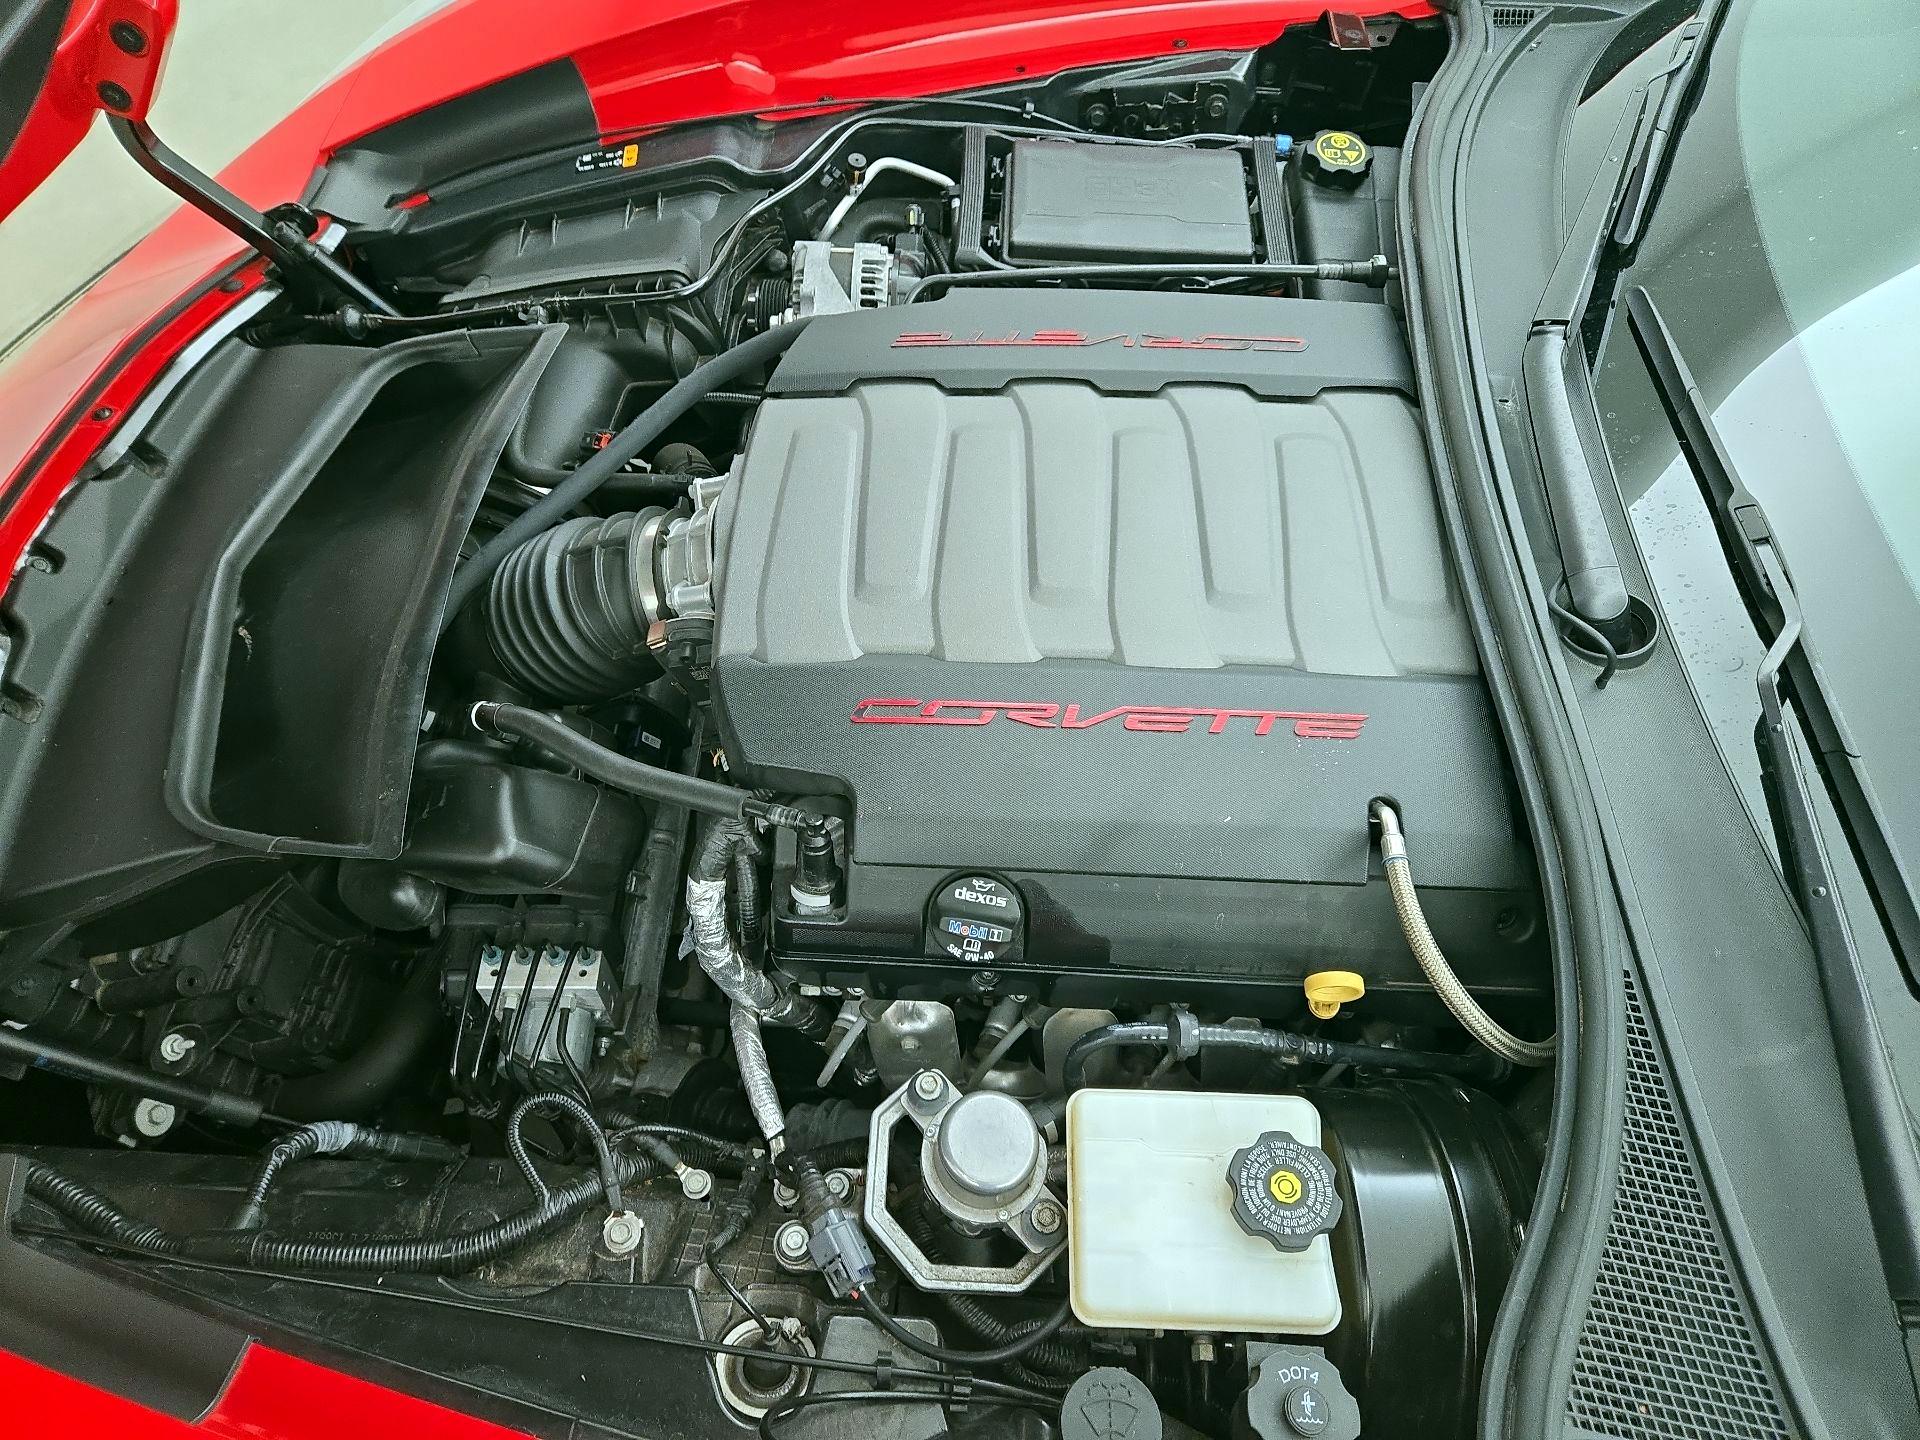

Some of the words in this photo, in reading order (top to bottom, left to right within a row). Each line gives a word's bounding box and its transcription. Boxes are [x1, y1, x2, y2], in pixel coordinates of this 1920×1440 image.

[890, 330, 1310, 352] CORVETTE
[849, 698, 1369, 739] CORVETTE
[954, 887, 1007, 907] dexos
[948, 920, 988, 940] Mobil
[947, 944, 963, 958] SAE
[965, 951, 995, 961] 0W-40
[1270, 1149, 1285, 1157] ONLY
[1286, 1150, 1297, 1158] USE
[1301, 1148, 1321, 1167] SEALED
[1243, 1159, 1252, 1168] LA
[1248, 1162, 1261, 1178] FREIN
[1274, 1158, 1295, 1166] FILLER
[1294, 1161, 1311, 1178] CLEAN
[1240, 1167, 1248, 1185] AVANT
[1320, 1169, 1330, 1186] FROM
[1250, 1188, 1263, 1209] LIQUIDE
[1316, 1180, 1324, 1203] BEFORE
[1324, 1187, 1332, 1204] FLUID
[1241, 1188, 1257, 1214] BOUCHON
[1312, 1202, 1323, 1213] CAP
[1255, 1213, 1264, 1222] LE
[1260, 1208, 1270, 1217] DU
[1269, 1214, 1282, 1224] QUE
[1275, 1205, 1309, 1218] PROVENANT
[1319, 1203, 1331, 1219] DOT4
[1262, 1218, 1291, 1235] NETTOYER
